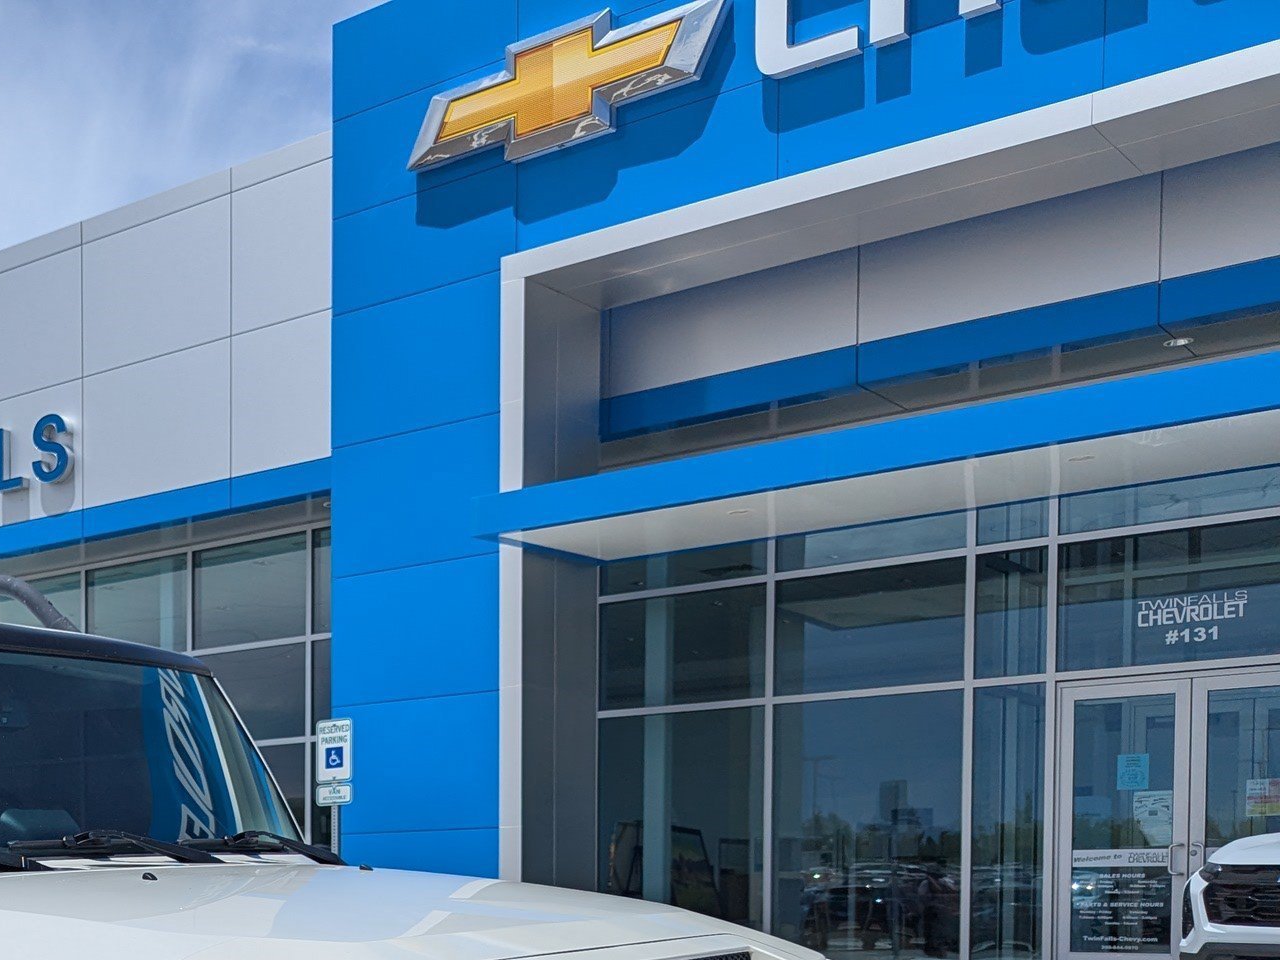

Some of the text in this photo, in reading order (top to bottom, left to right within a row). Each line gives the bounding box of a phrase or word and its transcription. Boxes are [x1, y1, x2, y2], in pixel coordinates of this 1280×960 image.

[1137, 590, 1248, 611] TWINFALLS
[1137, 601, 1248, 628] CHEVROLET
[1165, 626, 1219, 645] #131
[320, 724, 350, 734] RESERVED
[321, 735, 348, 745] PARKING
[1073, 855, 1112, 863] Welcome
